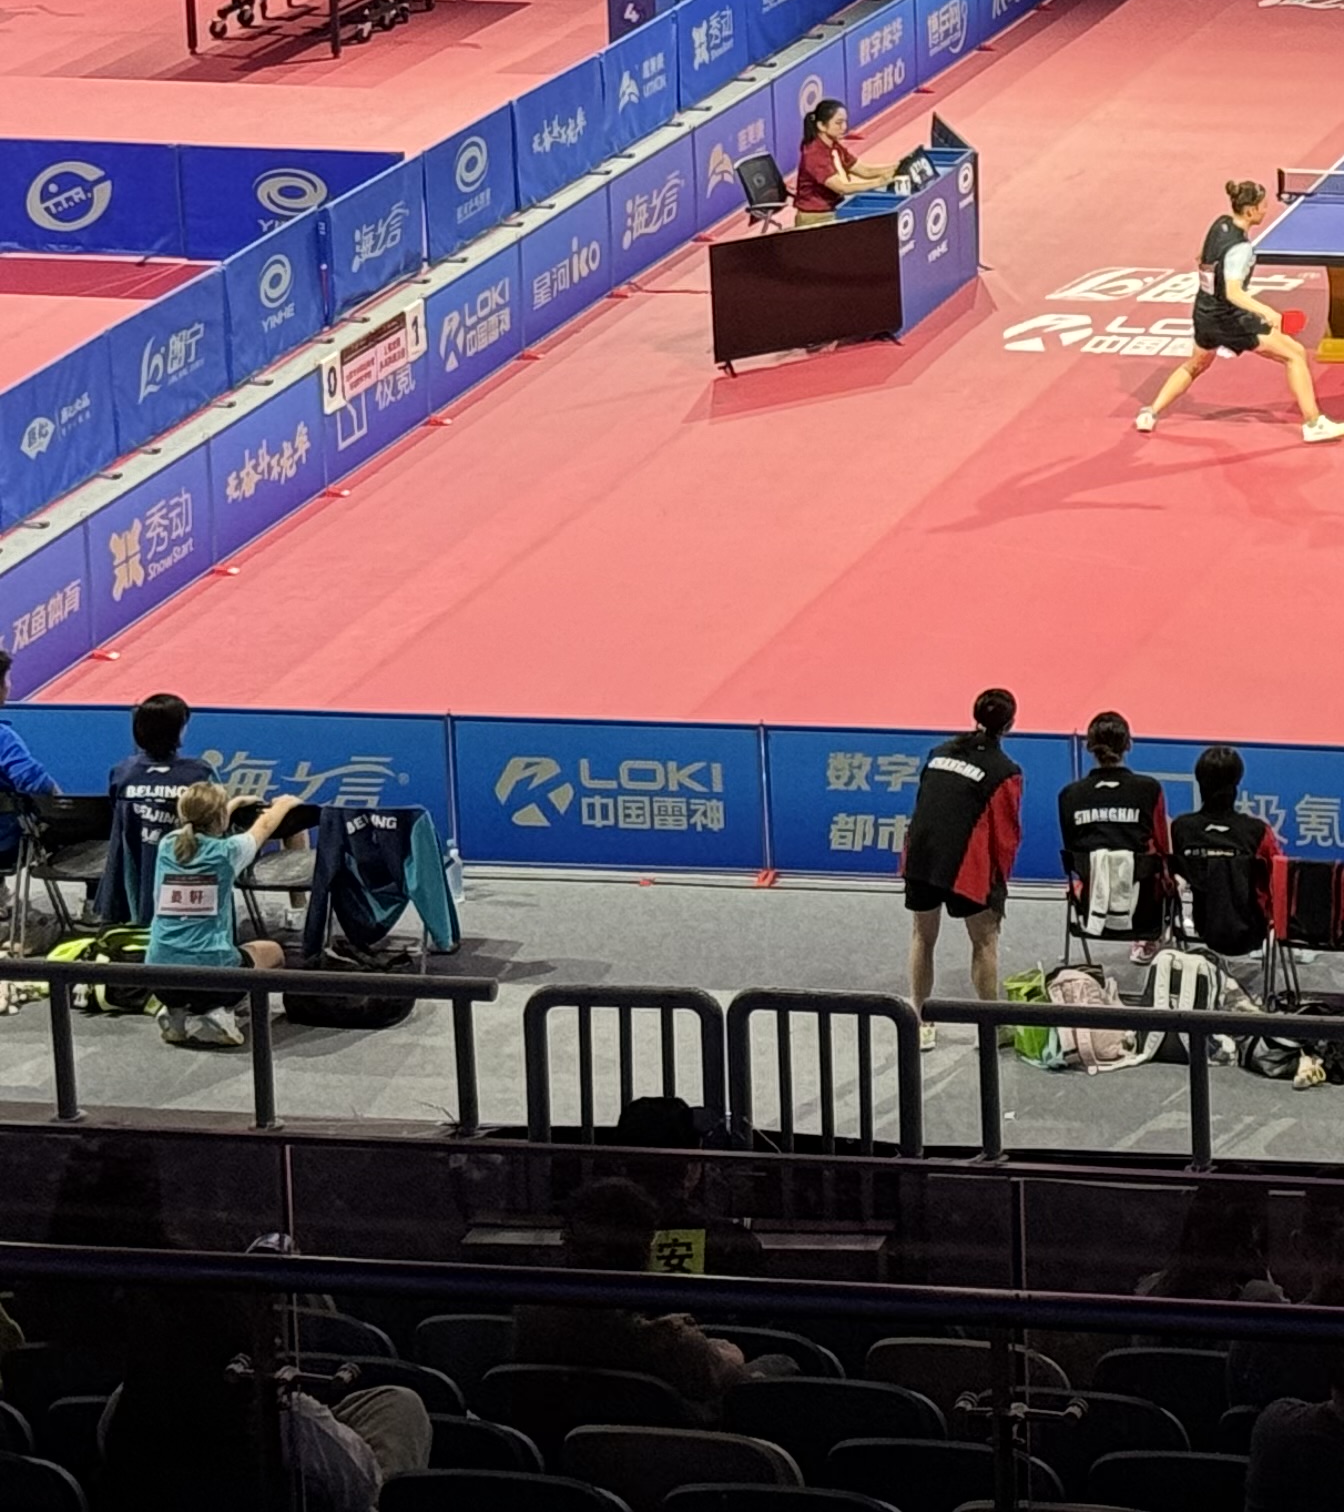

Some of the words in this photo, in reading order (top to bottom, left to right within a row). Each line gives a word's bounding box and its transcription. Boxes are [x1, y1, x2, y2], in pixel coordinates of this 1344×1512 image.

[623, 2, 640, 23] 4
[260, 301, 296, 333] YINHE
[463, 277, 511, 324] LOKI
[327, 365, 338, 398] 0
[145, 487, 193, 560] 秀动
[11, 579, 82, 655] 双鱼体育
[580, 758, 724, 792] LOKI
[580, 794, 726, 833] 中国雷神
[1074, 807, 1141, 827] SHANGHAI
